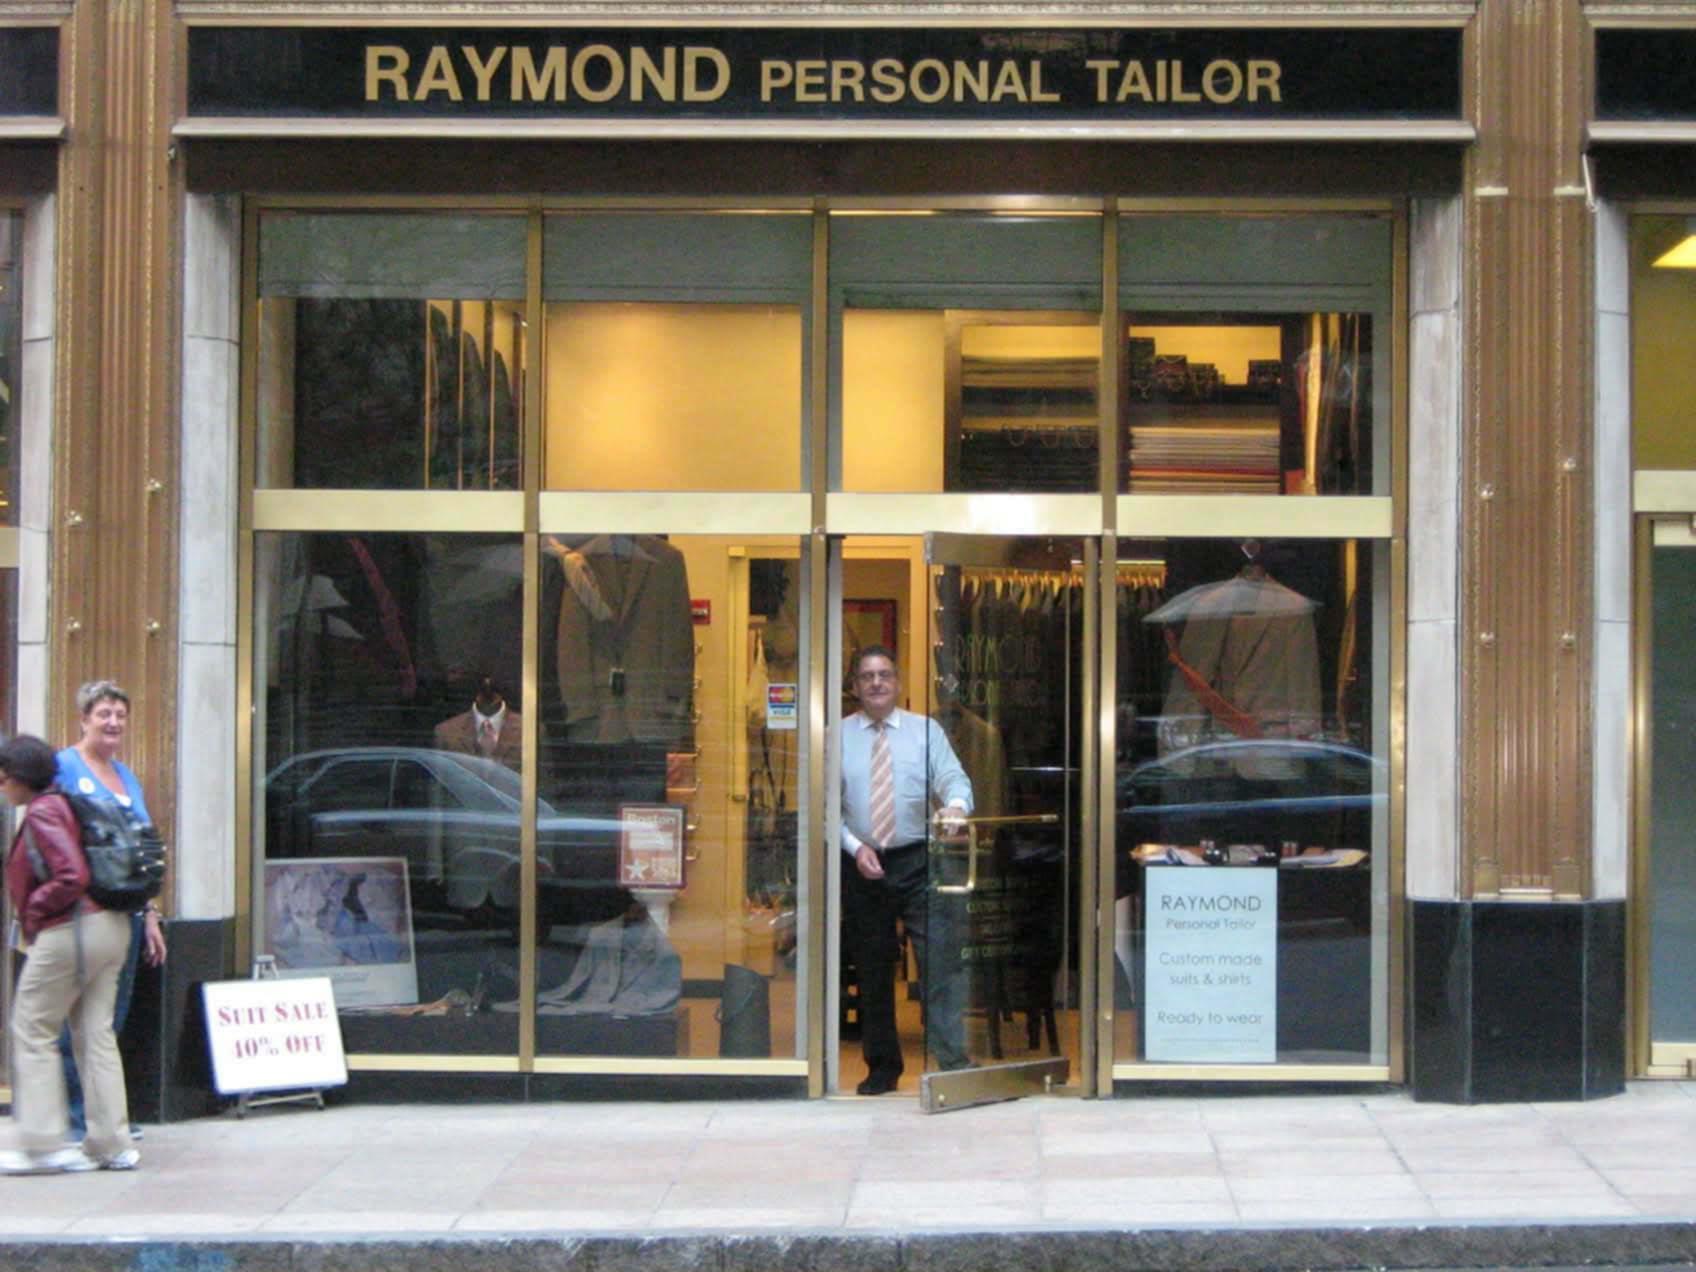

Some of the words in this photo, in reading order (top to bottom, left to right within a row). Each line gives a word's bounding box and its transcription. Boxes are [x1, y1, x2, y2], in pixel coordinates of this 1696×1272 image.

[364, 45, 731, 102] RAYMOND
[760, 59, 1060, 103] PERSONAL
[1086, 59, 1282, 103] TAILOR
[1160, 894, 1263, 913] RAYMOND
[1165, 917, 1220, 931] Personal
[1224, 917, 1257, 931] Tailor
[1158, 951, 1216, 967] Custom
[1218, 951, 1264, 967] made
[1169, 972, 1199, 986] suits
[1202, 973, 1214, 986] &
[1217, 972, 1252, 986] shirts
[217, 1006, 267, 1027] SUIT
[273, 1002, 329, 1022] SALE
[1156, 1010, 1204, 1026] Ready
[1208, 1010, 1223, 1025] to
[1226, 1013, 1264, 1025] wear
[285, 1032, 326, 1055] OFF
